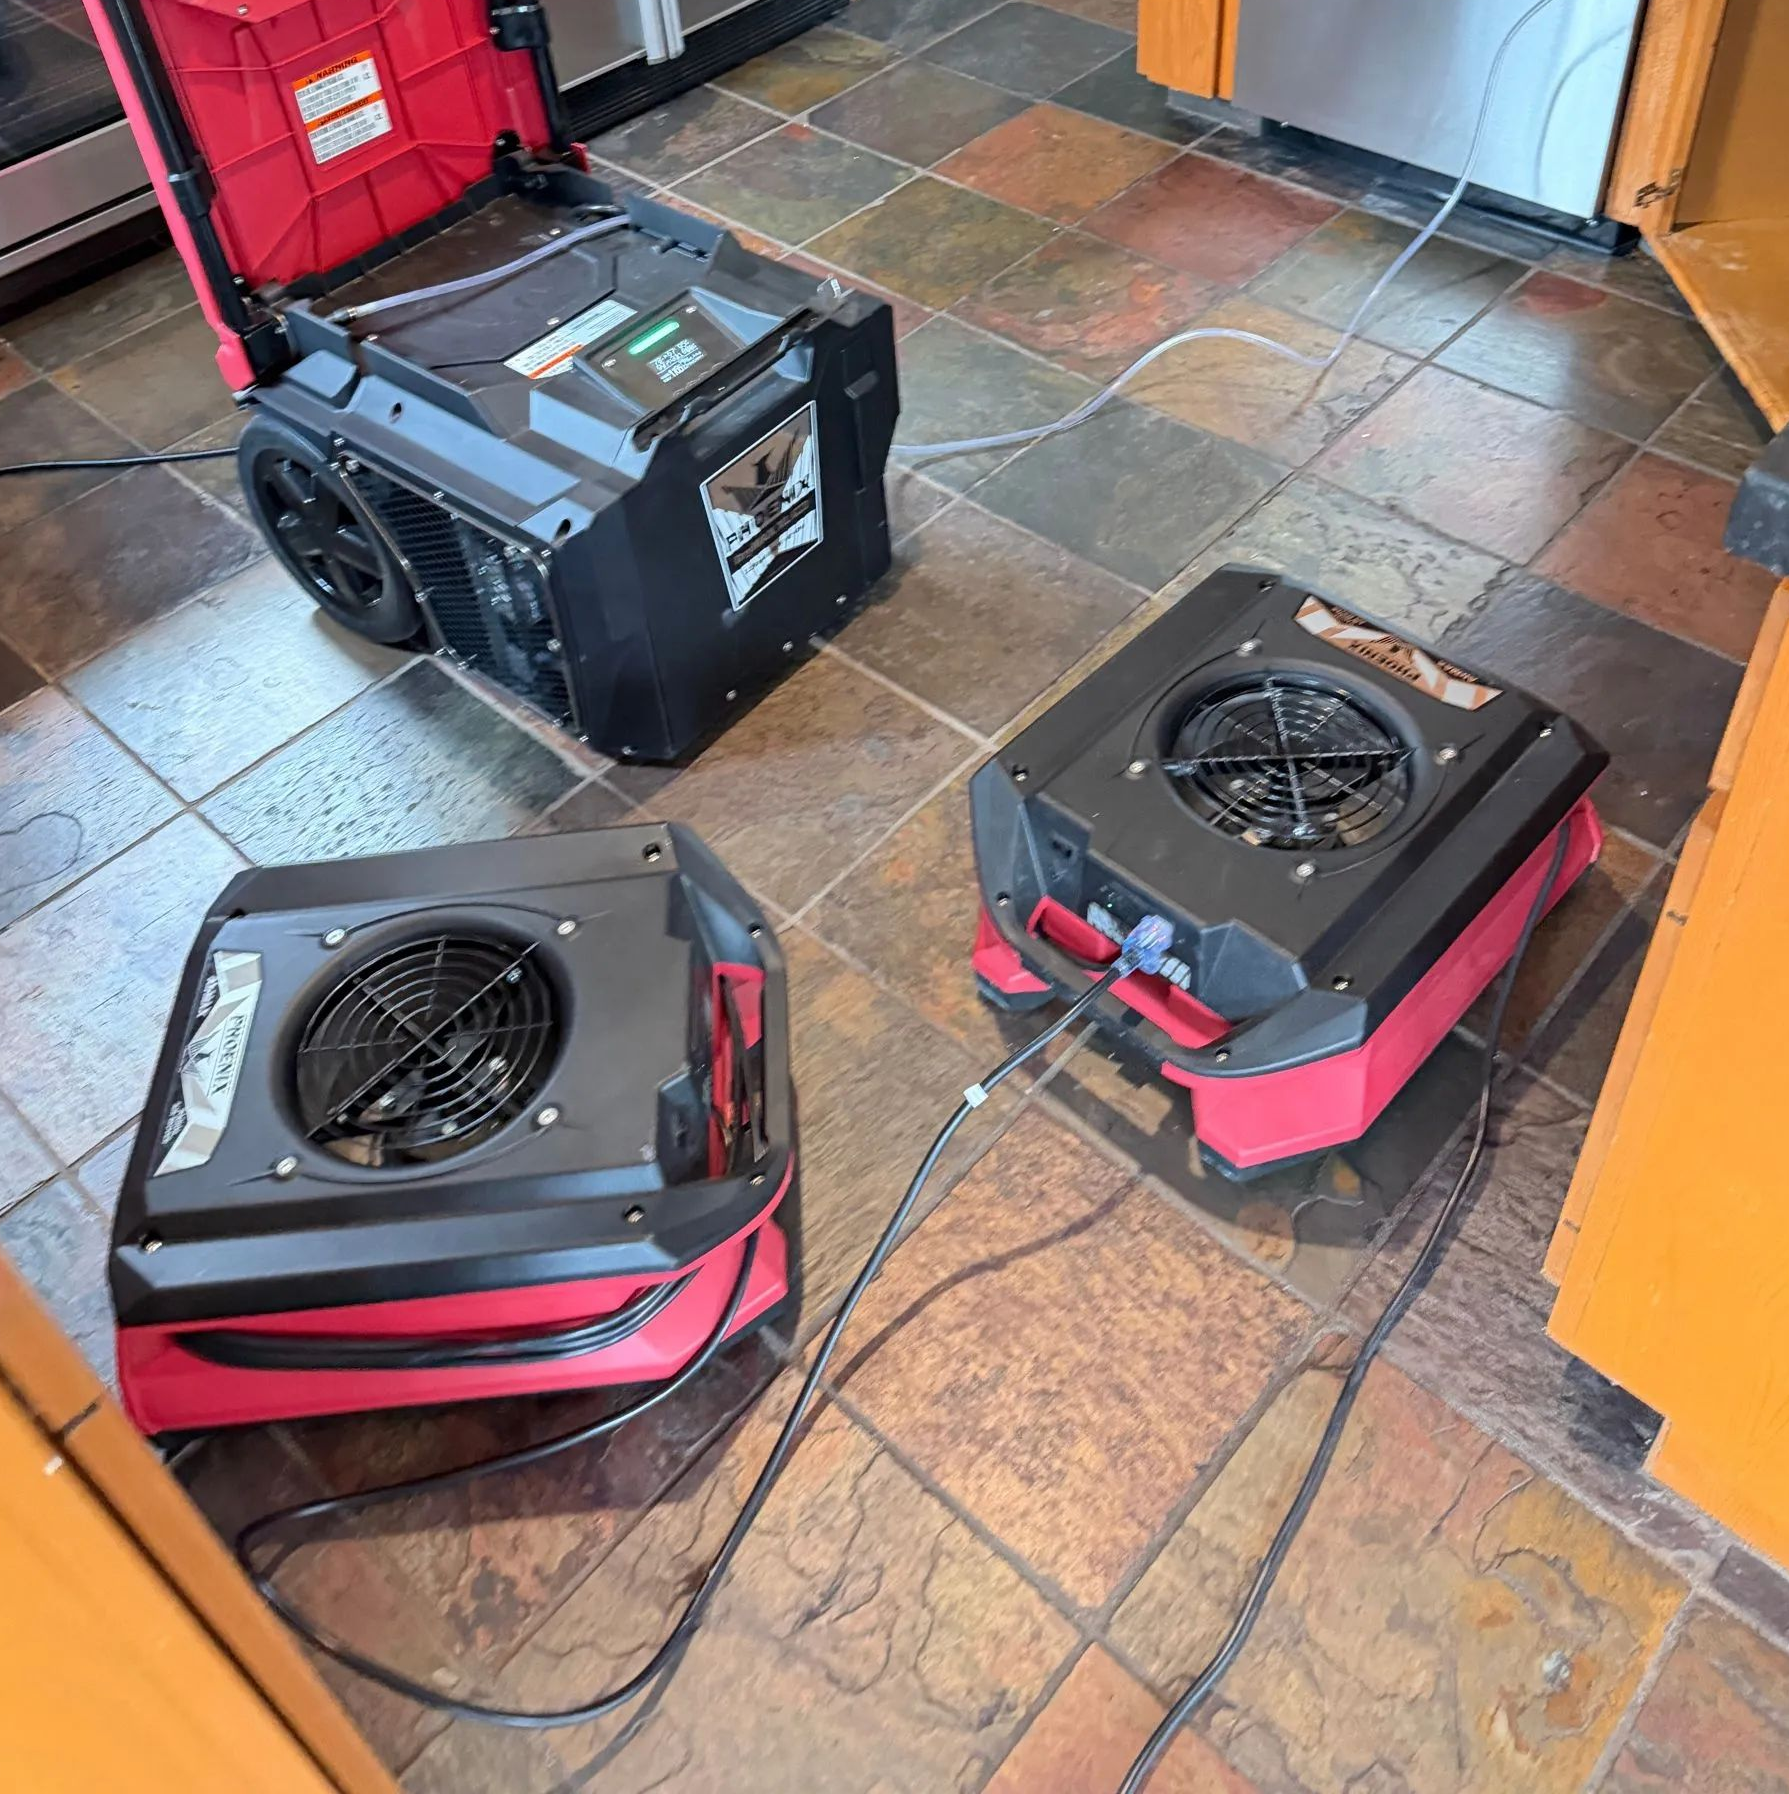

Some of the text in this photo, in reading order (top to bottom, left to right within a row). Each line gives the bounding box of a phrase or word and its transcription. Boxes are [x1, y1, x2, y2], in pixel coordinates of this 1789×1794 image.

[726, 473, 811, 548] PHOENIX
[1348, 640, 1422, 681] PHOENIX
[211, 1015, 246, 1096] PHOENIX
